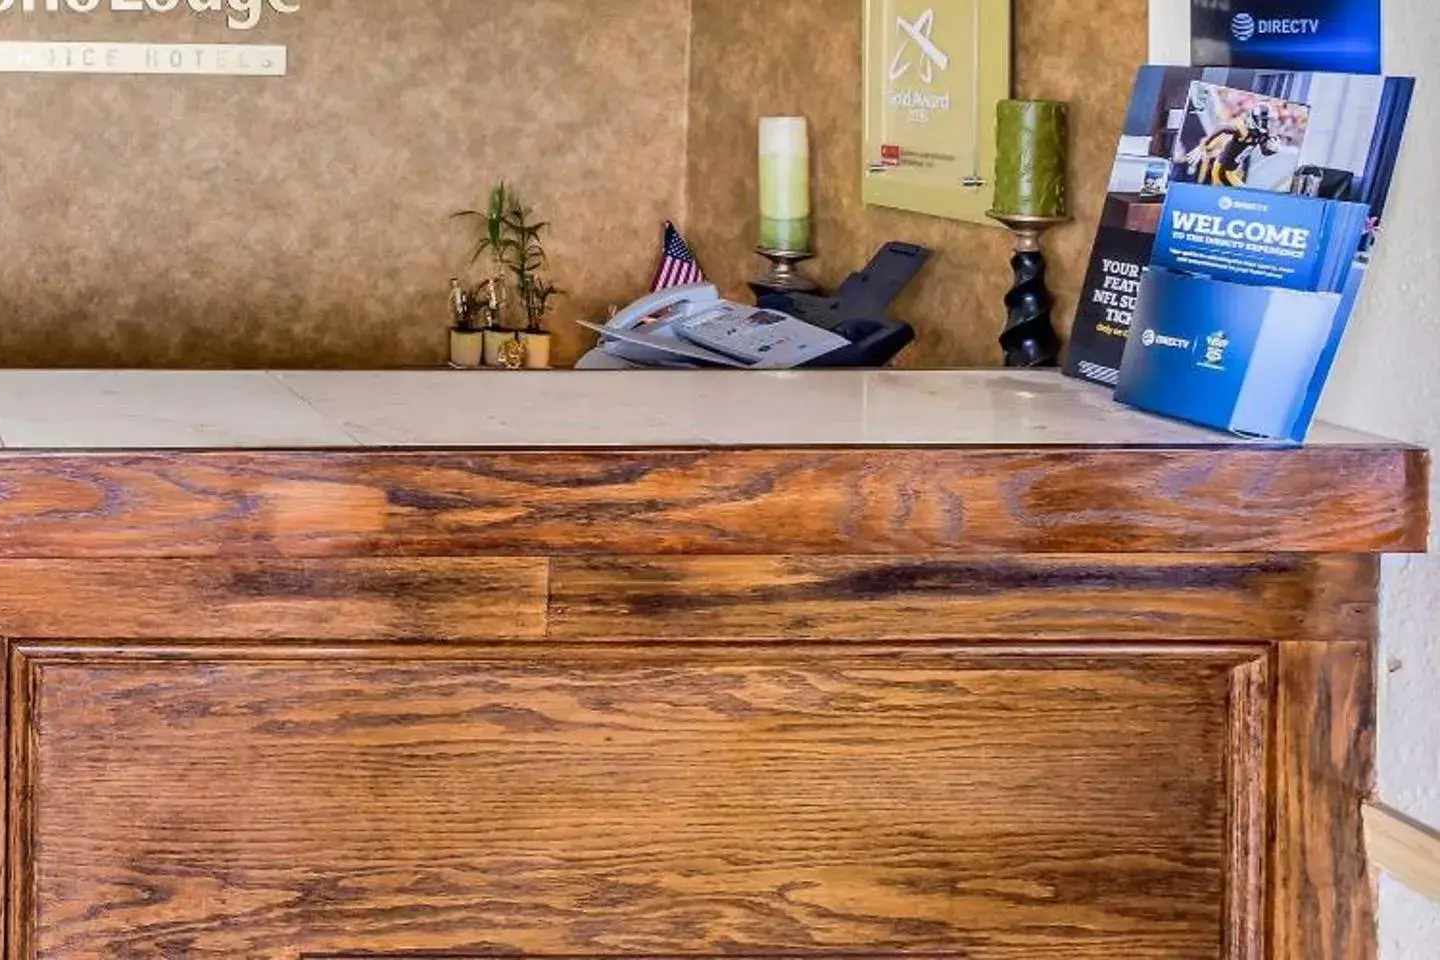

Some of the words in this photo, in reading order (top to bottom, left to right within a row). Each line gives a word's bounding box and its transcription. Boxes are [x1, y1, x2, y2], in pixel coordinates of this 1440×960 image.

[1258, 19, 1319, 34] DIRECTV
[1171, 210, 1310, 249] WELCOME
[1102, 259, 1140, 277] YOUR
[1092, 289, 1119, 306] NFL
